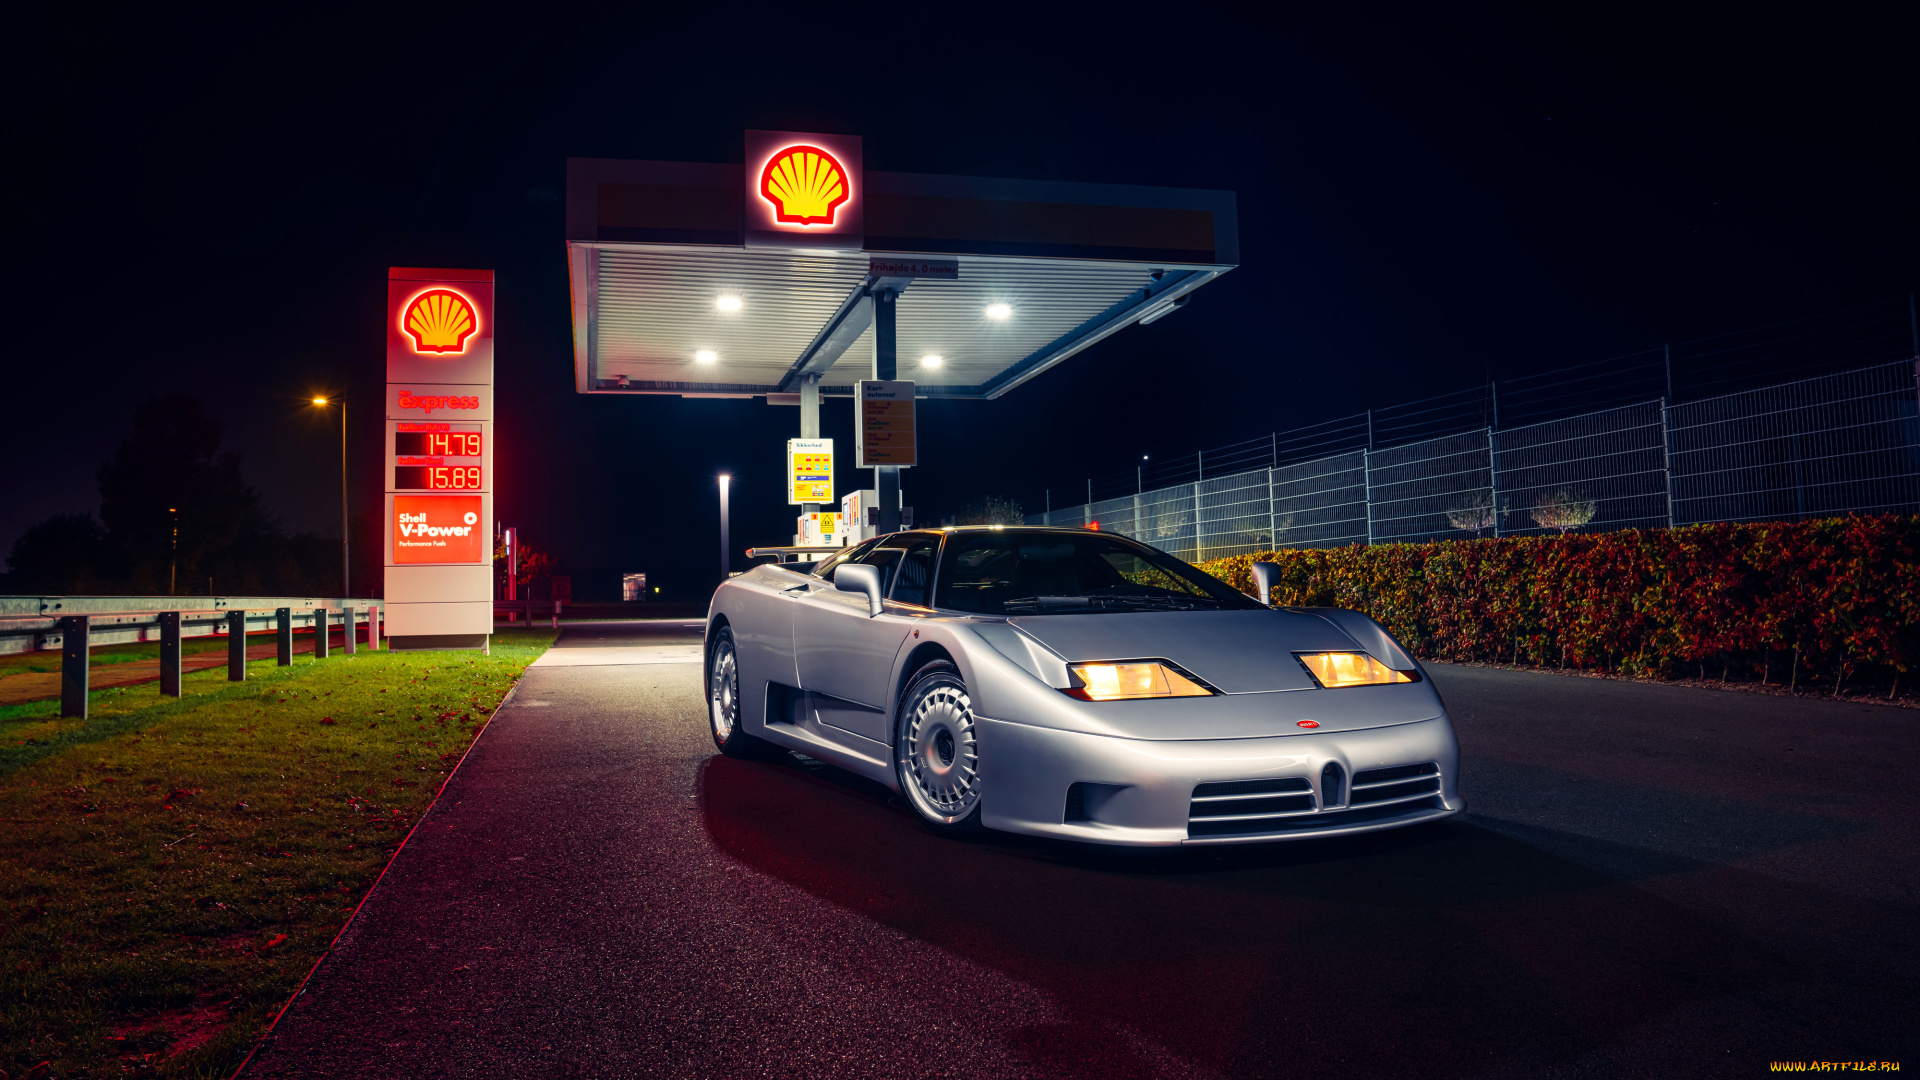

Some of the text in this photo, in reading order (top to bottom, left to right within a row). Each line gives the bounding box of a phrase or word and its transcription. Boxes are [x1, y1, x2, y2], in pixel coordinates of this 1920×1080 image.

[870, 263, 909, 274] Frihøjde
[930, 266, 958, 274] meter
[399, 396, 479, 414] express
[429, 434, 480, 455] 14.79
[429, 468, 480, 488] 15.89
[399, 513, 426, 523] Shell
[399, 523, 472, 537] V-Power
